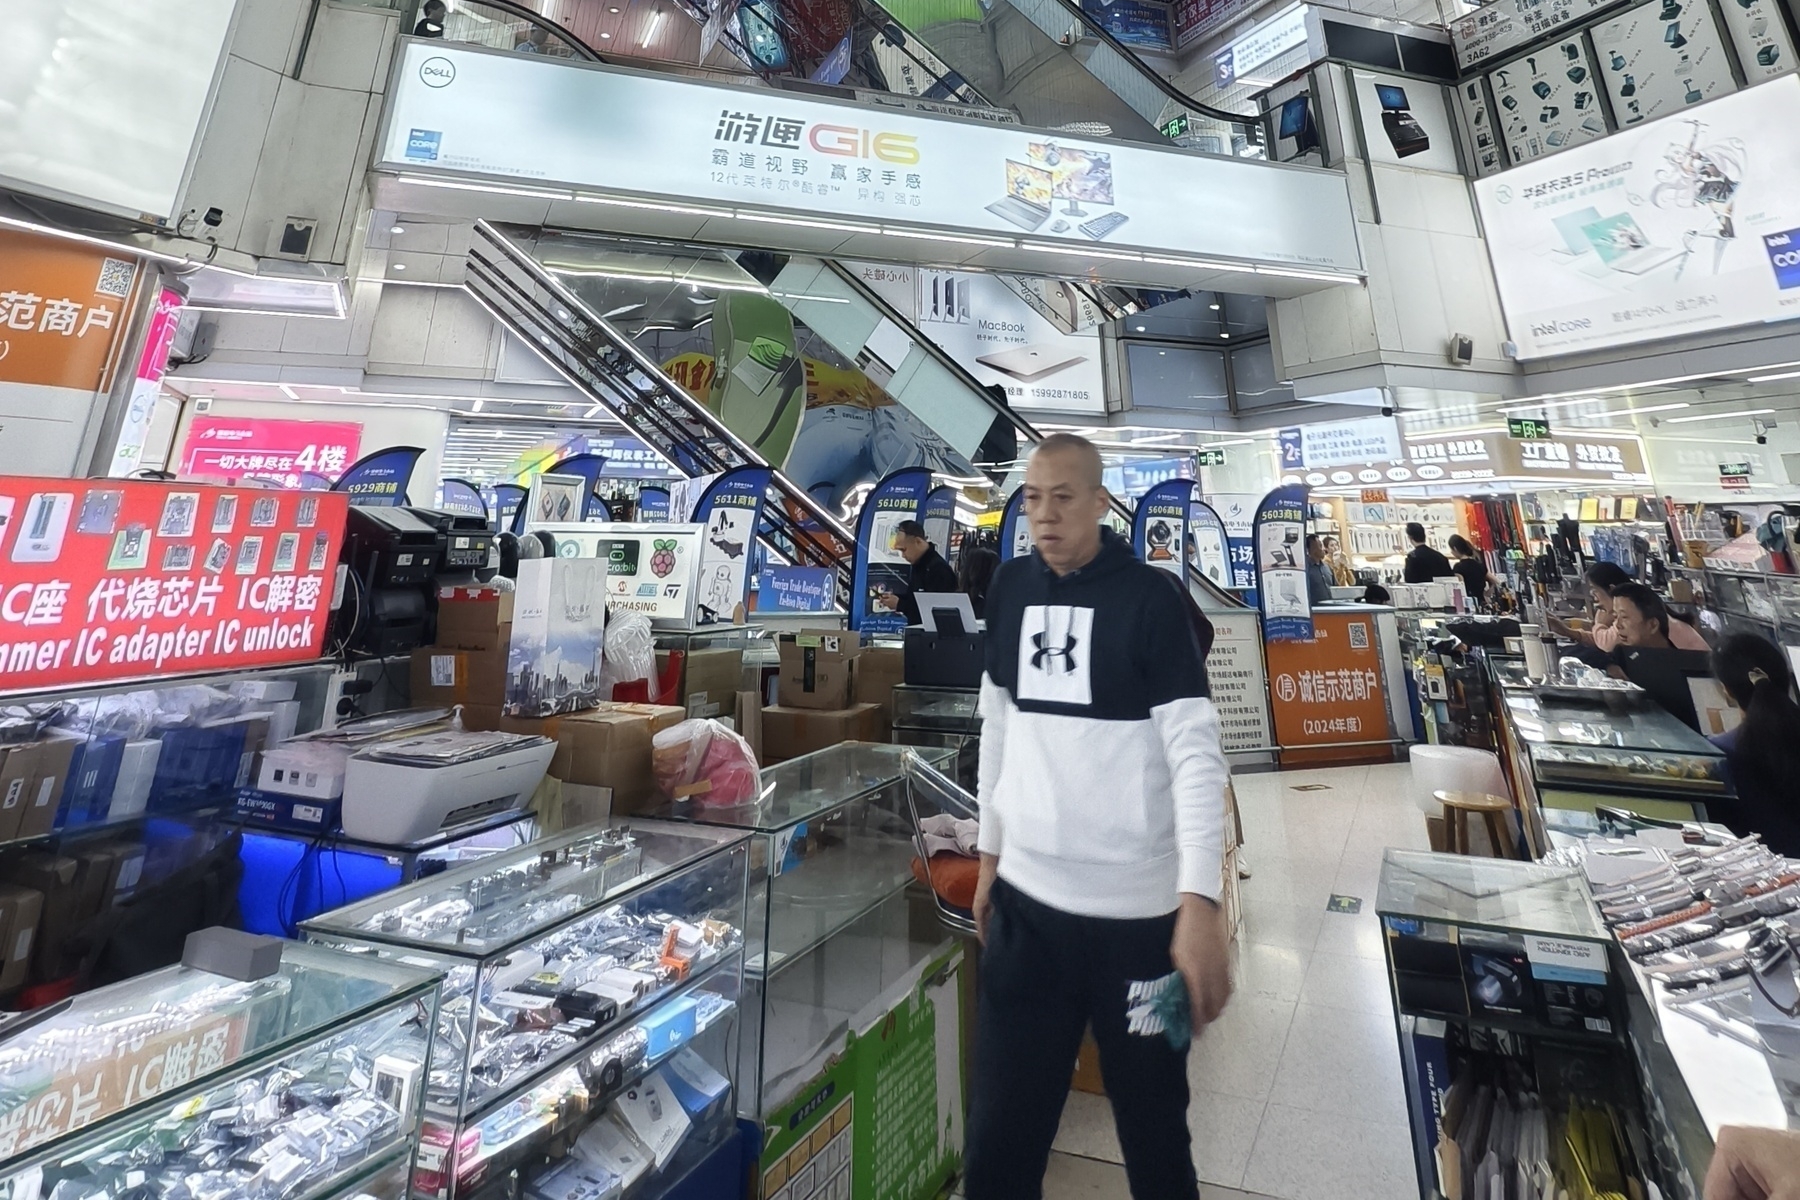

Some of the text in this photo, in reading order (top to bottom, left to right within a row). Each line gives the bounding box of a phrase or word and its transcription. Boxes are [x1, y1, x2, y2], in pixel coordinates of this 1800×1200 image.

[1531, 9, 1571, 34] 扫描设备
[1467, 45, 1490, 64] 3A62
[424, 66, 452, 78] DELL
[714, 109, 920, 165] 游匣 G16
[711, 148, 921, 189] 霸道视野 赢家手感
[978, 319, 1025, 333] MacBook
[205, 444, 348, 473] 一切大牌尽在 4楼
[714, 494, 757, 508] 5611商铺
[877, 498, 918, 510] 5610商铺
[1148, 506, 1183, 517] 5606商铺
[1261, 510, 1302, 521] 5603商铺
[87, 575, 225, 623] 代烧芯片
[237, 575, 323, 613] IC解密
[73, 627, 107, 668] IC
[110, 622, 212, 668] adapter
[214, 618, 240, 655] IC
[243, 615, 316, 652] unlock
[1298, 668, 1378, 703] 诚信示范商户
[1303, 716, 1362, 736] (2024年度)
